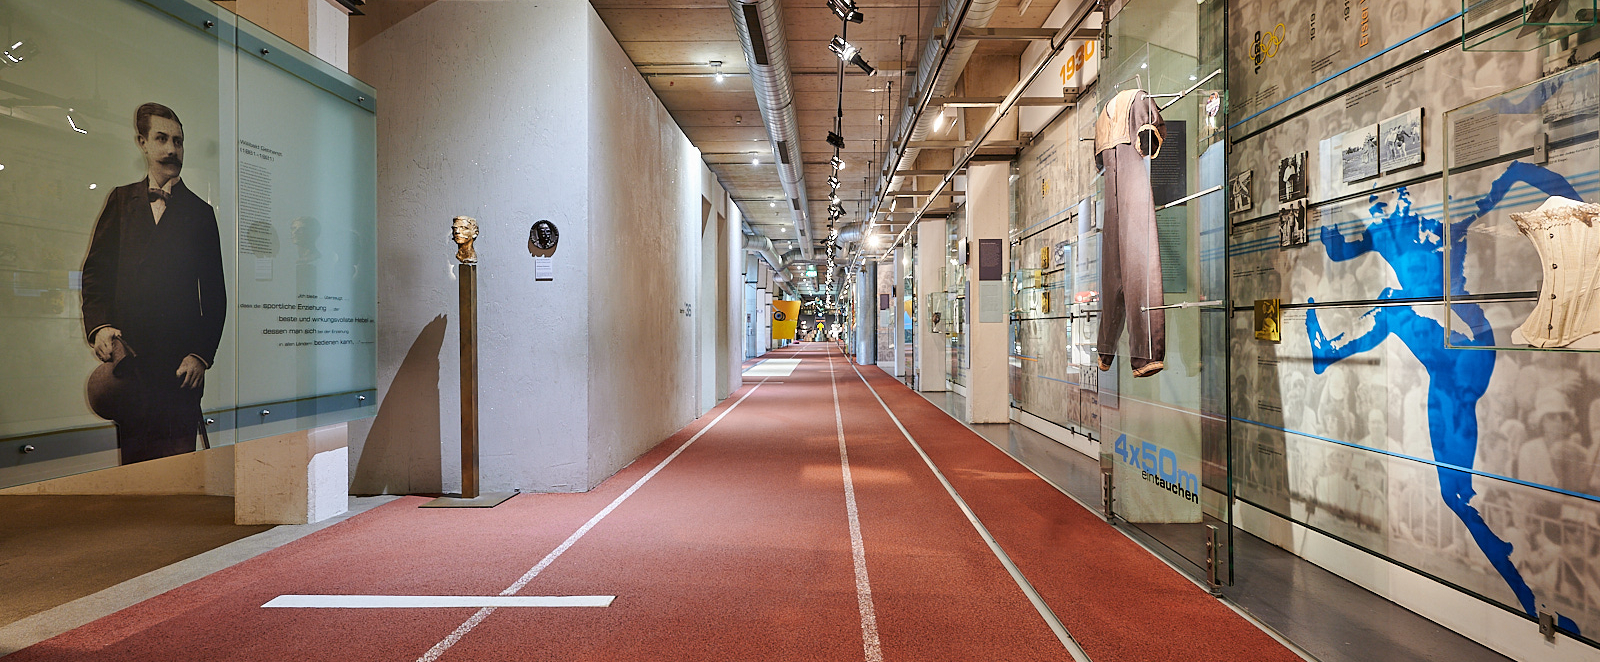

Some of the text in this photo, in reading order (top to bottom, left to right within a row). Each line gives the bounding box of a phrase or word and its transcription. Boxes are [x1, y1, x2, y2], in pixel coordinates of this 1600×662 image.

[1359, 6, 1369, 48] Erster
[1060, 40, 1095, 85] 1930
[297, 303, 327, 312] Erziehung
[1114, 433, 1199, 496] 4x50m
[1141, 469, 1199, 505] eintauchen
